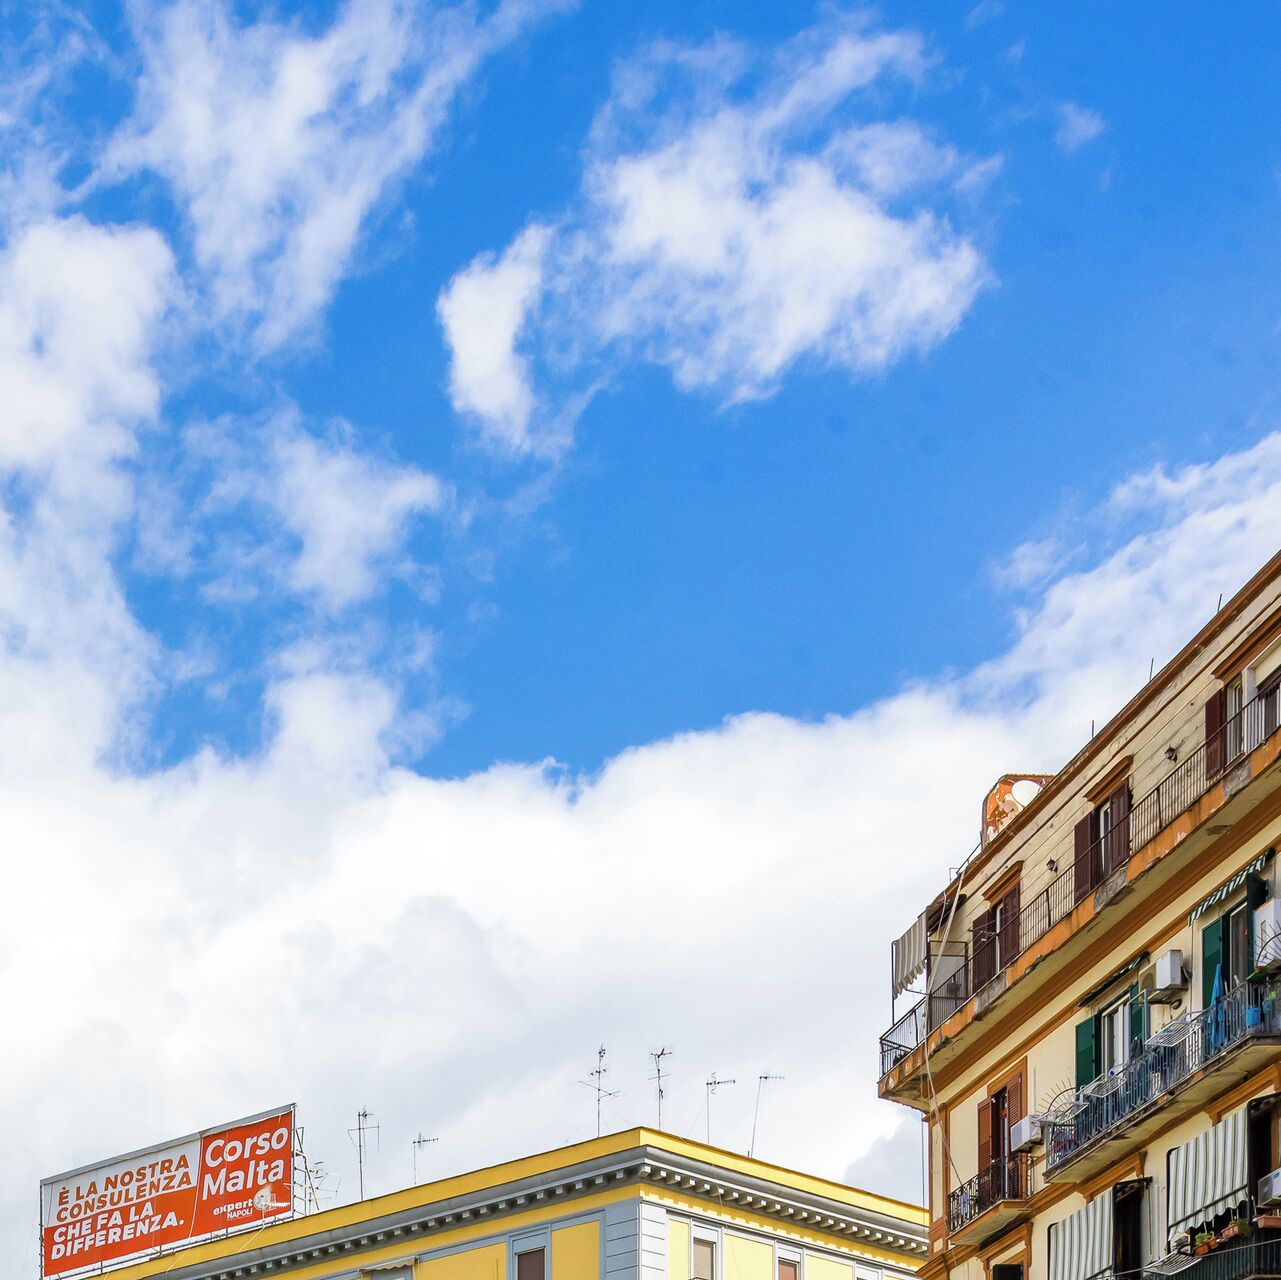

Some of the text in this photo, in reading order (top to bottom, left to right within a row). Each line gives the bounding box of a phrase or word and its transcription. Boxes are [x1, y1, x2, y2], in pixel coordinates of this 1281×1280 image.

[205, 1127, 289, 1168] Corso
[57, 1172, 192, 1223] CONSULENZA
[58, 1154, 189, 1206] È LA NOSTRA
[202, 1159, 285, 1201] Malta
[53, 1201, 154, 1243] CHE FA LA
[213, 1198, 253, 1216] expert
[227, 1208, 253, 1220] NAPOLI
[51, 1211, 185, 1260] DIFFERENZA.
